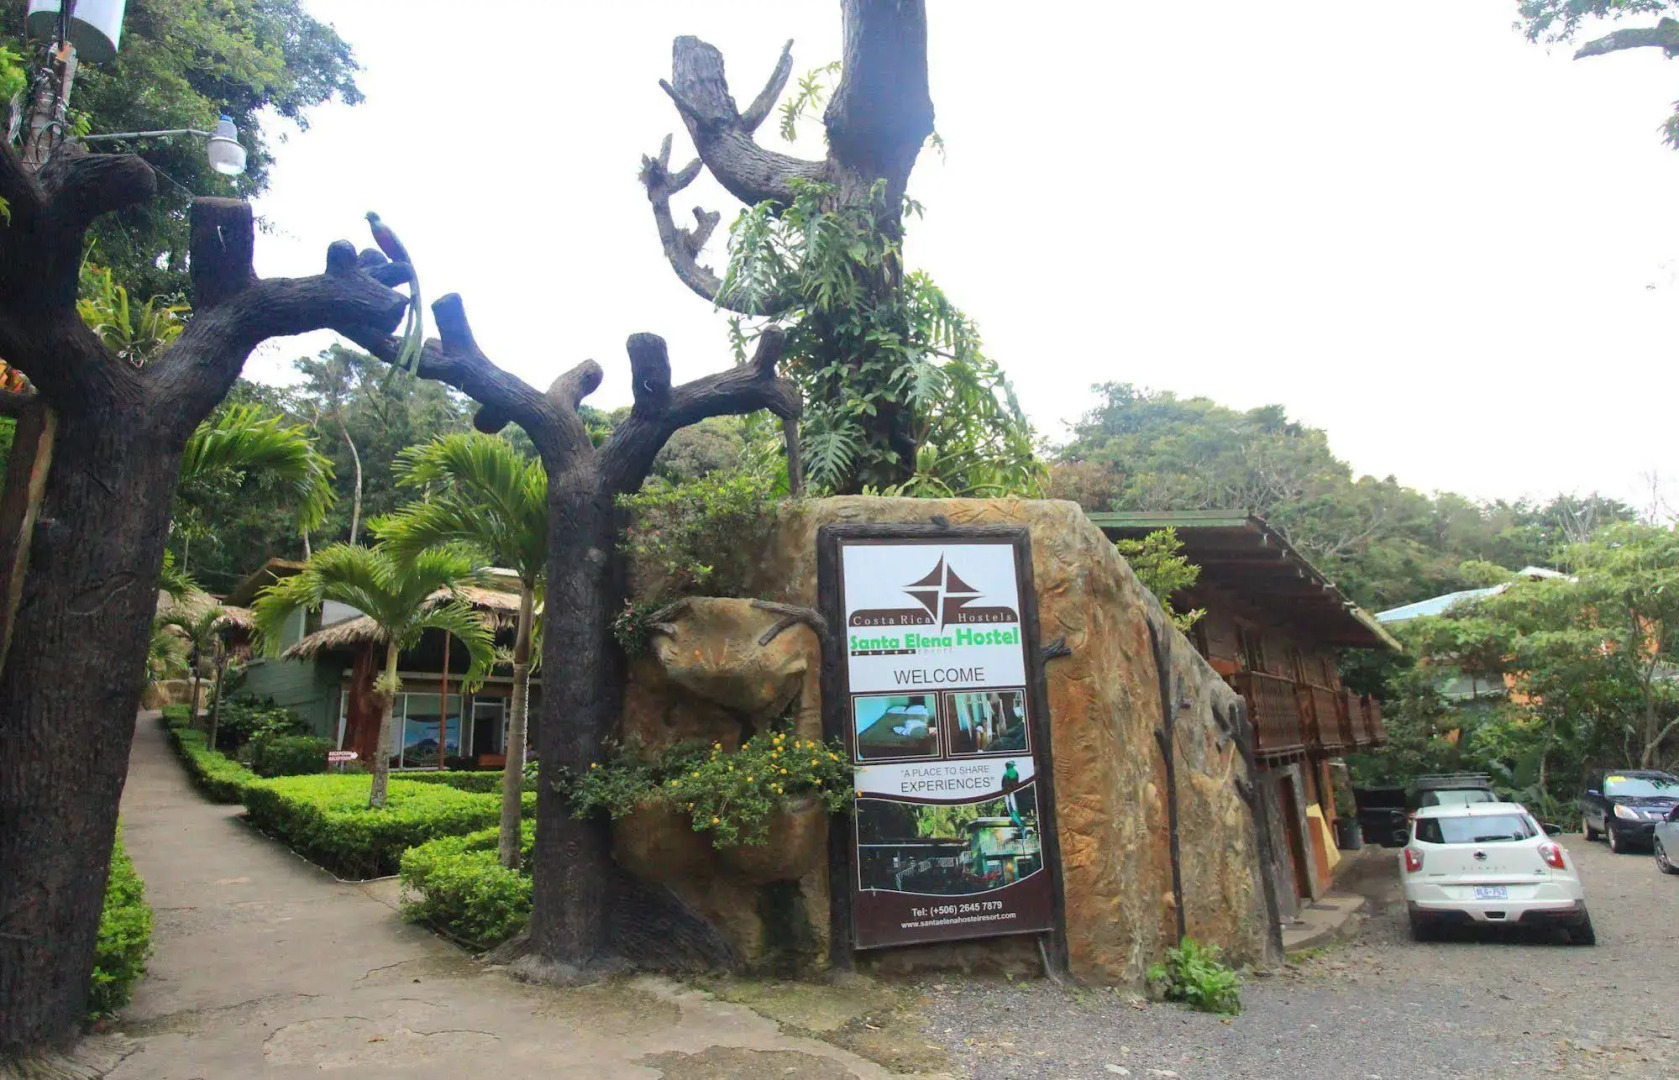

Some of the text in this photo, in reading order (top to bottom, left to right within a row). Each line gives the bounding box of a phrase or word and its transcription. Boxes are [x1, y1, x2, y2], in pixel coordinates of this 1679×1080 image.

[853, 612, 1012, 626] Costa Rica Hostels
[850, 627, 1019, 650] Santa Elena Hostel
[893, 667, 985, 685] WELCOME
[912, 767, 941, 777] PLACE
[944, 766, 957, 776] TO
[959, 764, 990, 774] SHARE
[901, 776, 995, 793] EXPERIENCES"
[911, 901, 1003, 917] Tel: (+506) 2645 7879
